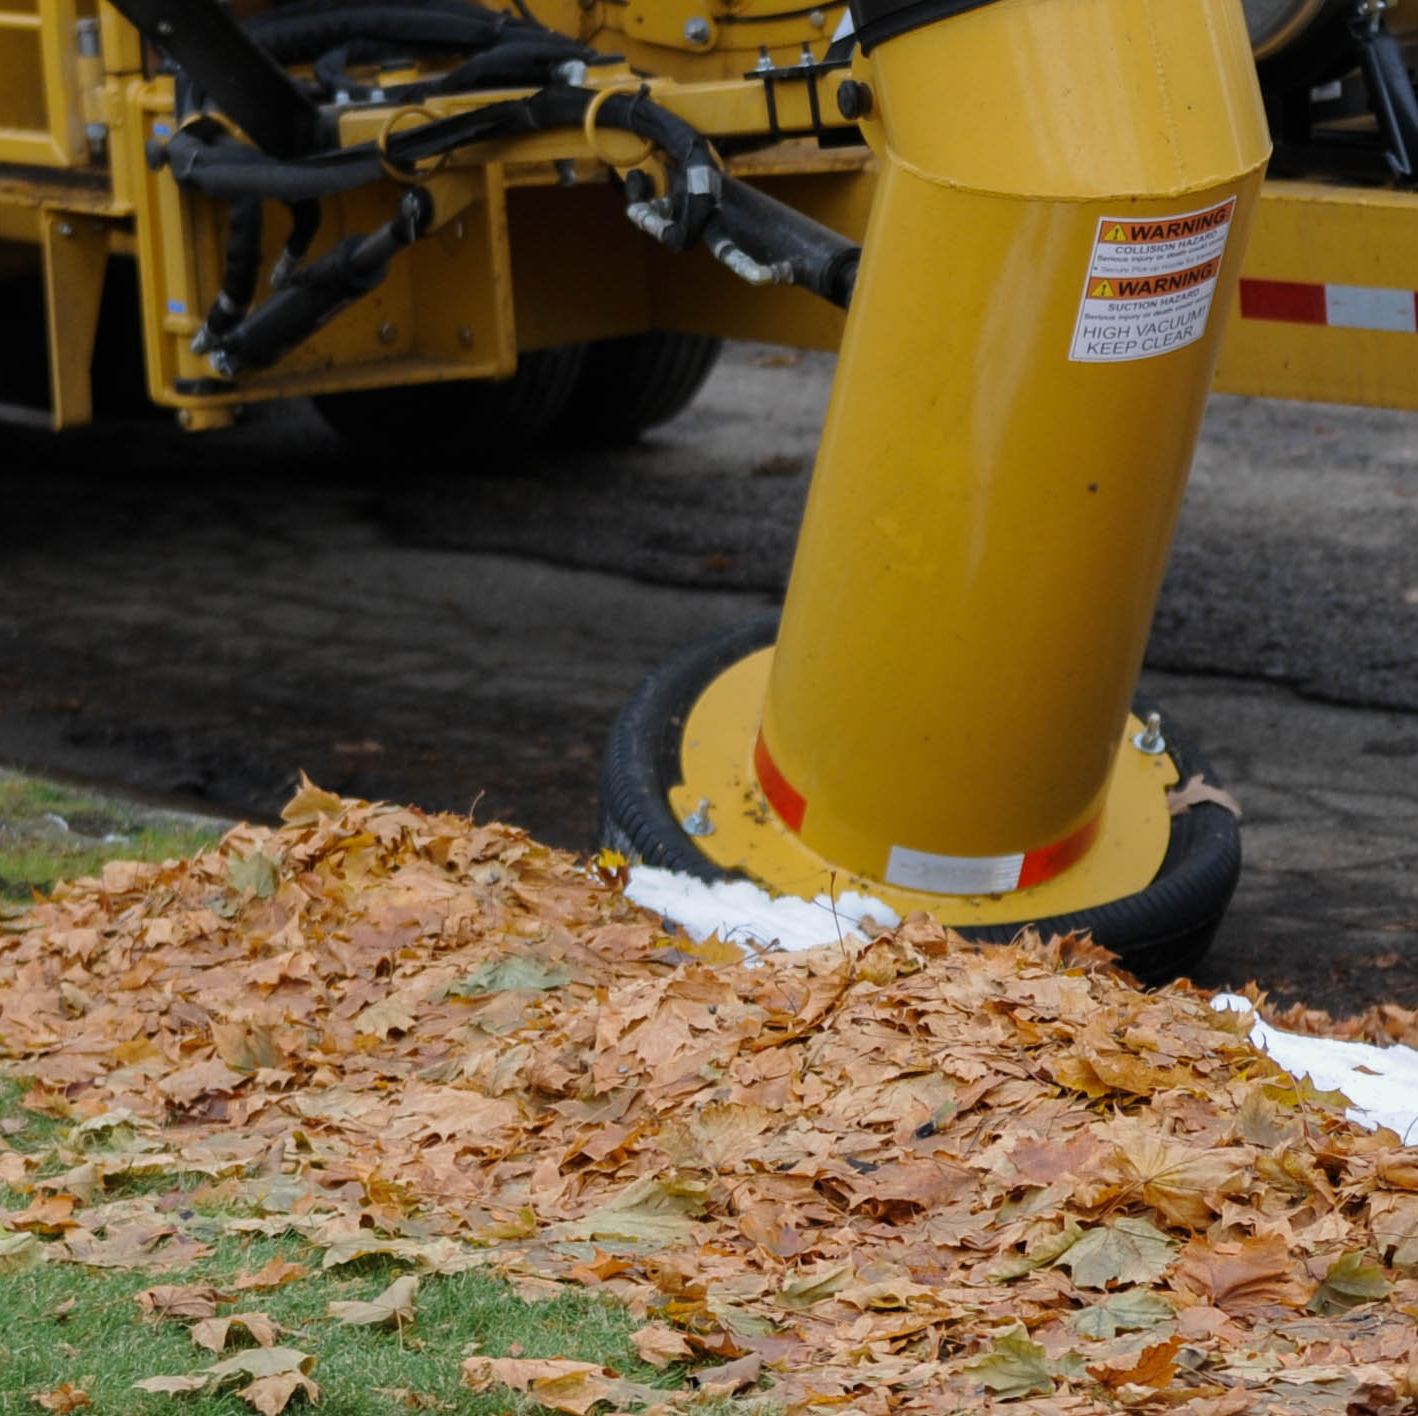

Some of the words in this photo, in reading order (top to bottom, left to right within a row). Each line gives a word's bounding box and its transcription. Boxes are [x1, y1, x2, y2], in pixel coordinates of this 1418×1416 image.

[1130, 208, 1226, 241] WARNING
[1115, 244, 1176, 255] COLLISION
[1179, 230, 1218, 248] HAZARD
[1097, 254, 1129, 263] Serious
[1118, 264, 1213, 297] WARNING
[1108, 300, 1158, 312] SUCTION
[1161, 288, 1200, 304] HAZARD
[1084, 312, 1116, 321] Serious
[1083, 325, 1131, 340] HIGH
[1086, 340, 1138, 356] KEEP
[1141, 326, 1194, 352] CLEAR
